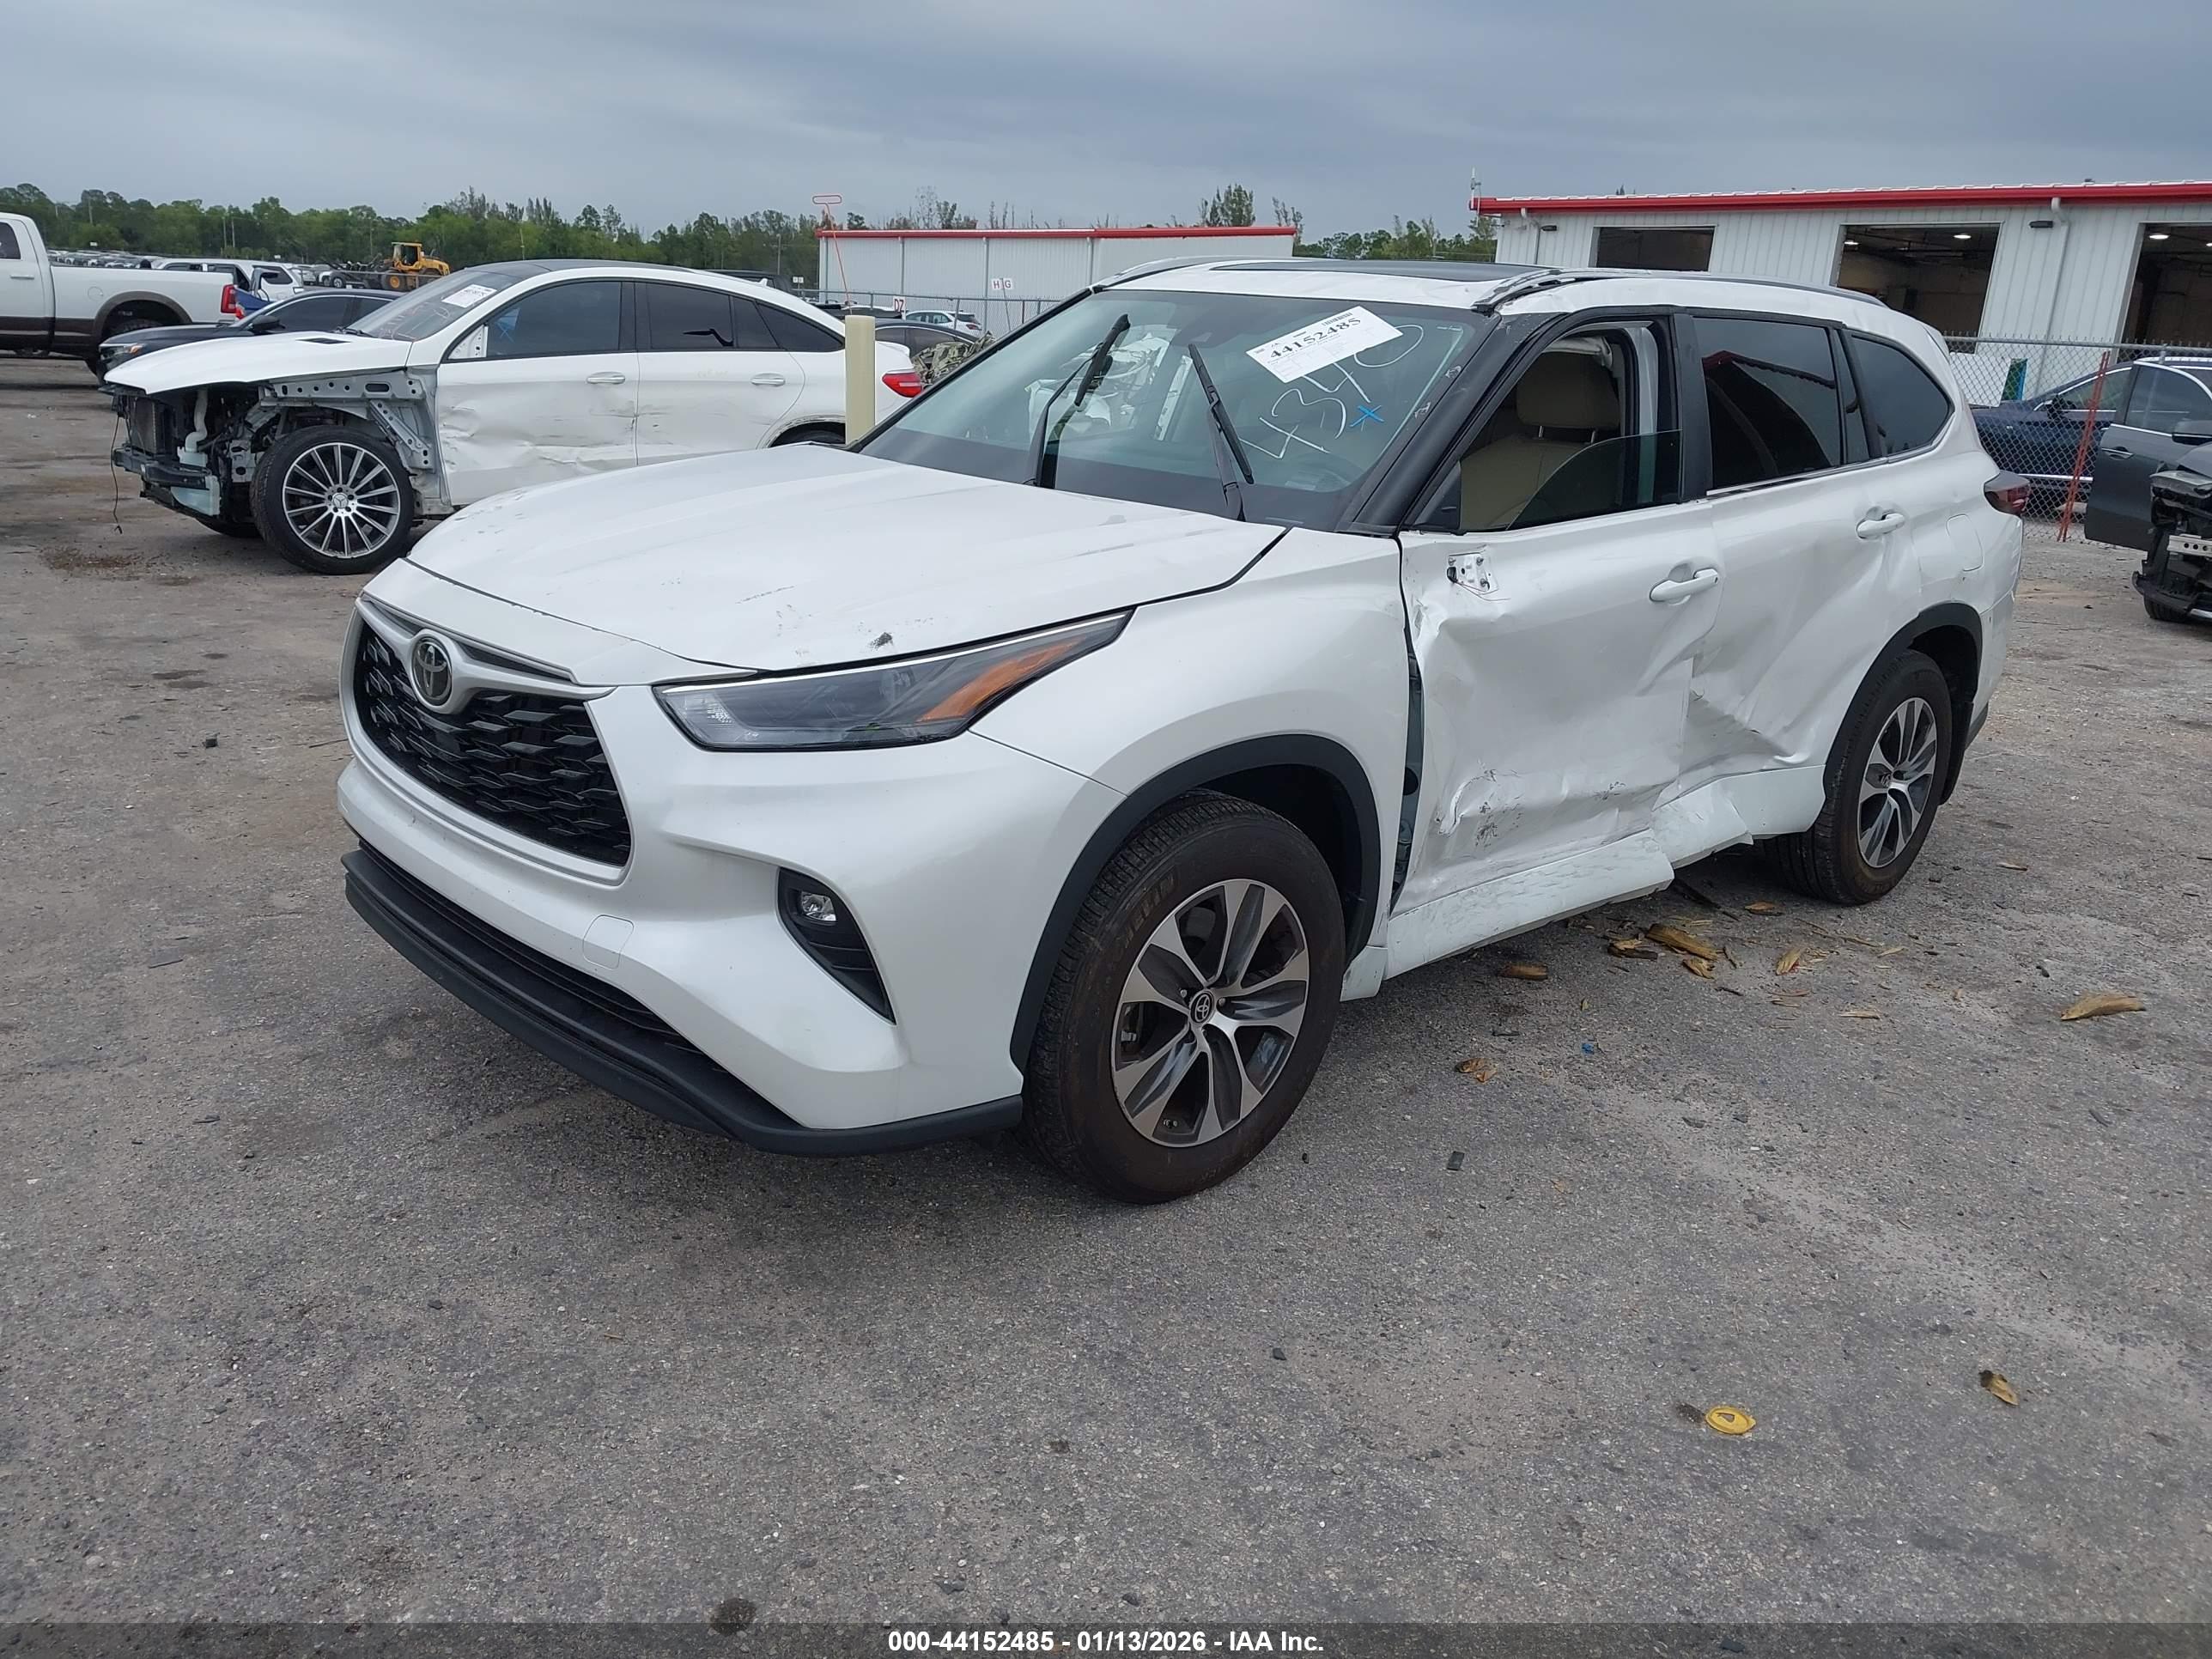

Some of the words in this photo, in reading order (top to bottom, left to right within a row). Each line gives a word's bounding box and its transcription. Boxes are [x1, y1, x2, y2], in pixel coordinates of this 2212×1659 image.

[993, 280, 1000, 289] H
[1004, 279, 1012, 289] G
[1270, 318, 1361, 358] 44152485
